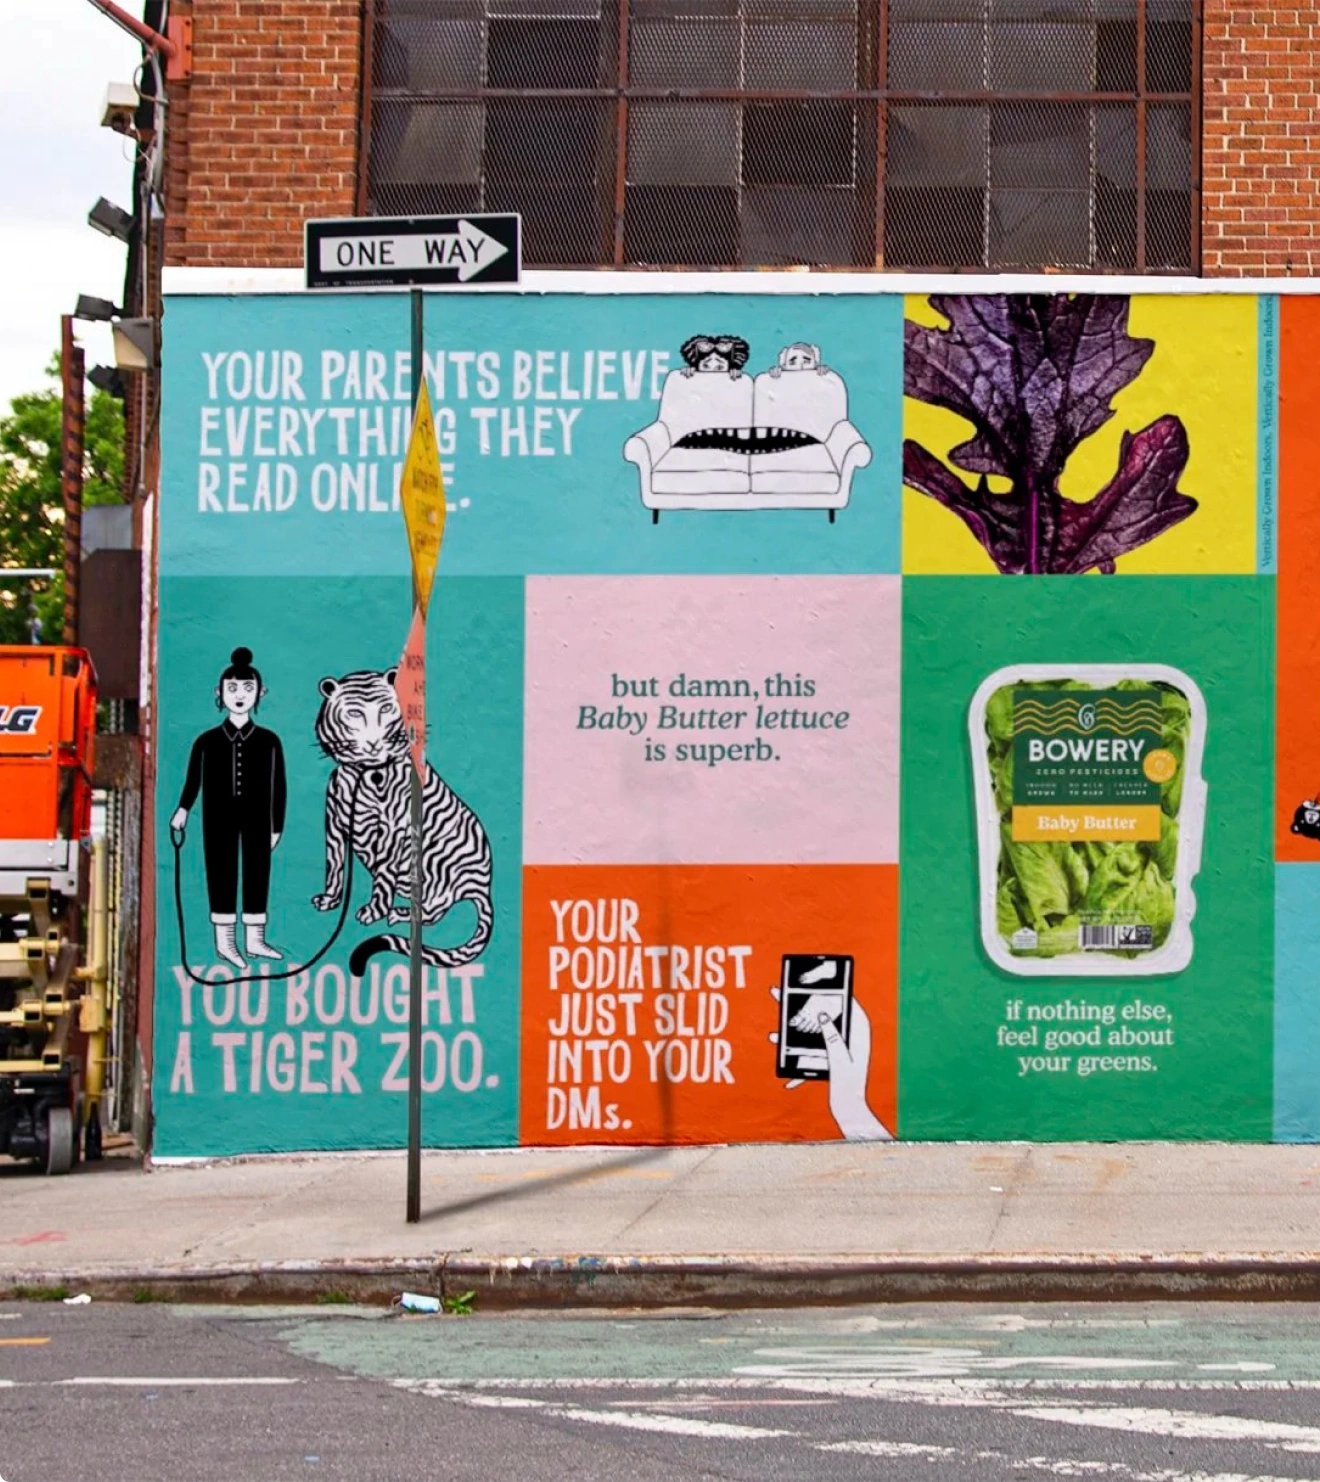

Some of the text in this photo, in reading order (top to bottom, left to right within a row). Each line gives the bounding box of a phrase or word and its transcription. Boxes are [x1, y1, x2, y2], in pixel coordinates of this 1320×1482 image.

[336, 238, 485, 267] ONE WAY
[202, 349, 671, 402] YOUR PARENTS BELIEVE
[201, 405, 582, 457] EVERYTHIG THEY
[198, 462, 297, 512] READ
[312, 461, 469, 513] ONLIE.
[1262, 478, 1273, 514] Grown
[1261, 517, 1274, 569] Vertically
[612, 673, 815, 701] but damn, this
[577, 705, 849, 735] Baby Butter lettuce
[645, 737, 780, 767] is superb.
[1029, 739, 1146, 761] BOWERY
[1038, 815, 1137, 832] Baby Butter
[551, 899, 641, 944] YOUR
[549, 945, 752, 990] PODIATRIST
[172, 963, 485, 1026] YOU BOUGHT
[549, 992, 728, 1037] JUST SLID
[1006, 999, 1172, 1025] if nothing else,
[997, 1025, 1173, 1050] feel good about
[170, 1030, 500, 1094] A TIGER ZOO.
[548, 1039, 734, 1084] INTO YOUR
[1018, 1056, 1157, 1076] your greens.
[547, 1086, 632, 1130] DMs.
